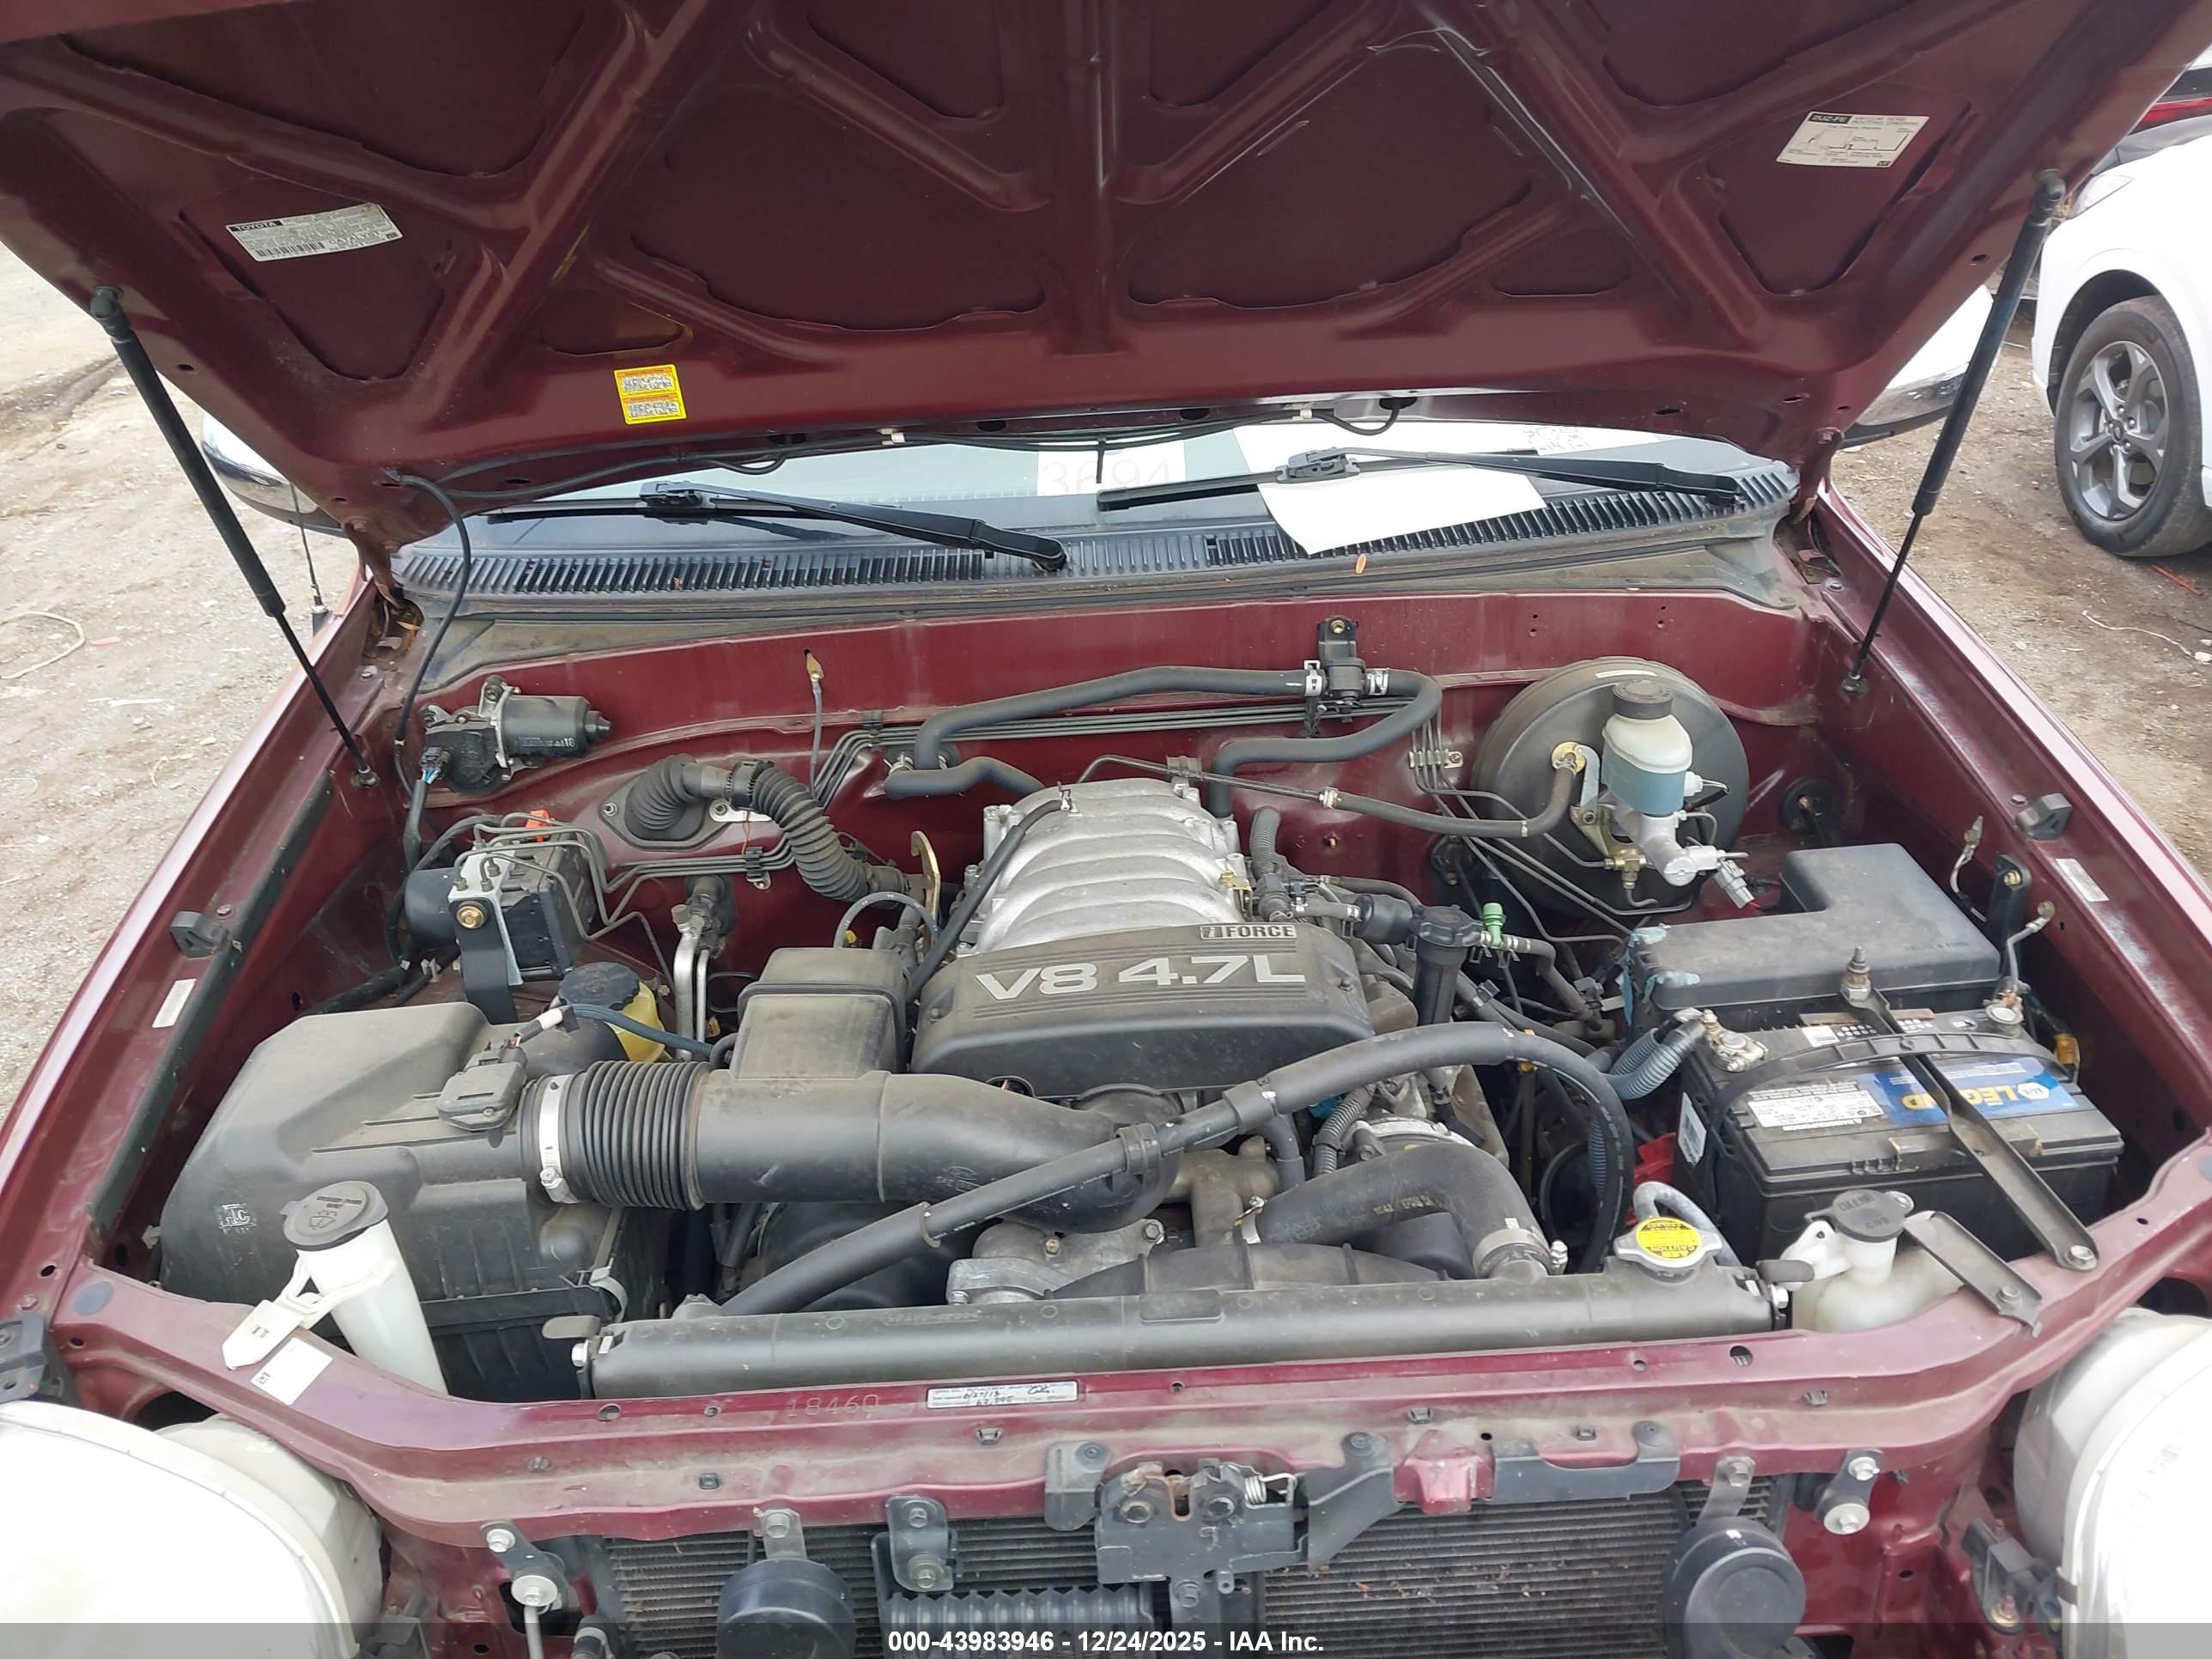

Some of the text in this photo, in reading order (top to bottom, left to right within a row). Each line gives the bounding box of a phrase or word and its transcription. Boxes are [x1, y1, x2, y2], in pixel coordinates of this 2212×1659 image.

[237, 221, 277, 231] TOYOTA
[975, 955, 1307, 1001] V8 4.7L
[1650, 1244, 1695, 1253] CAUTION
[785, 1394, 880, 1418] 18460
